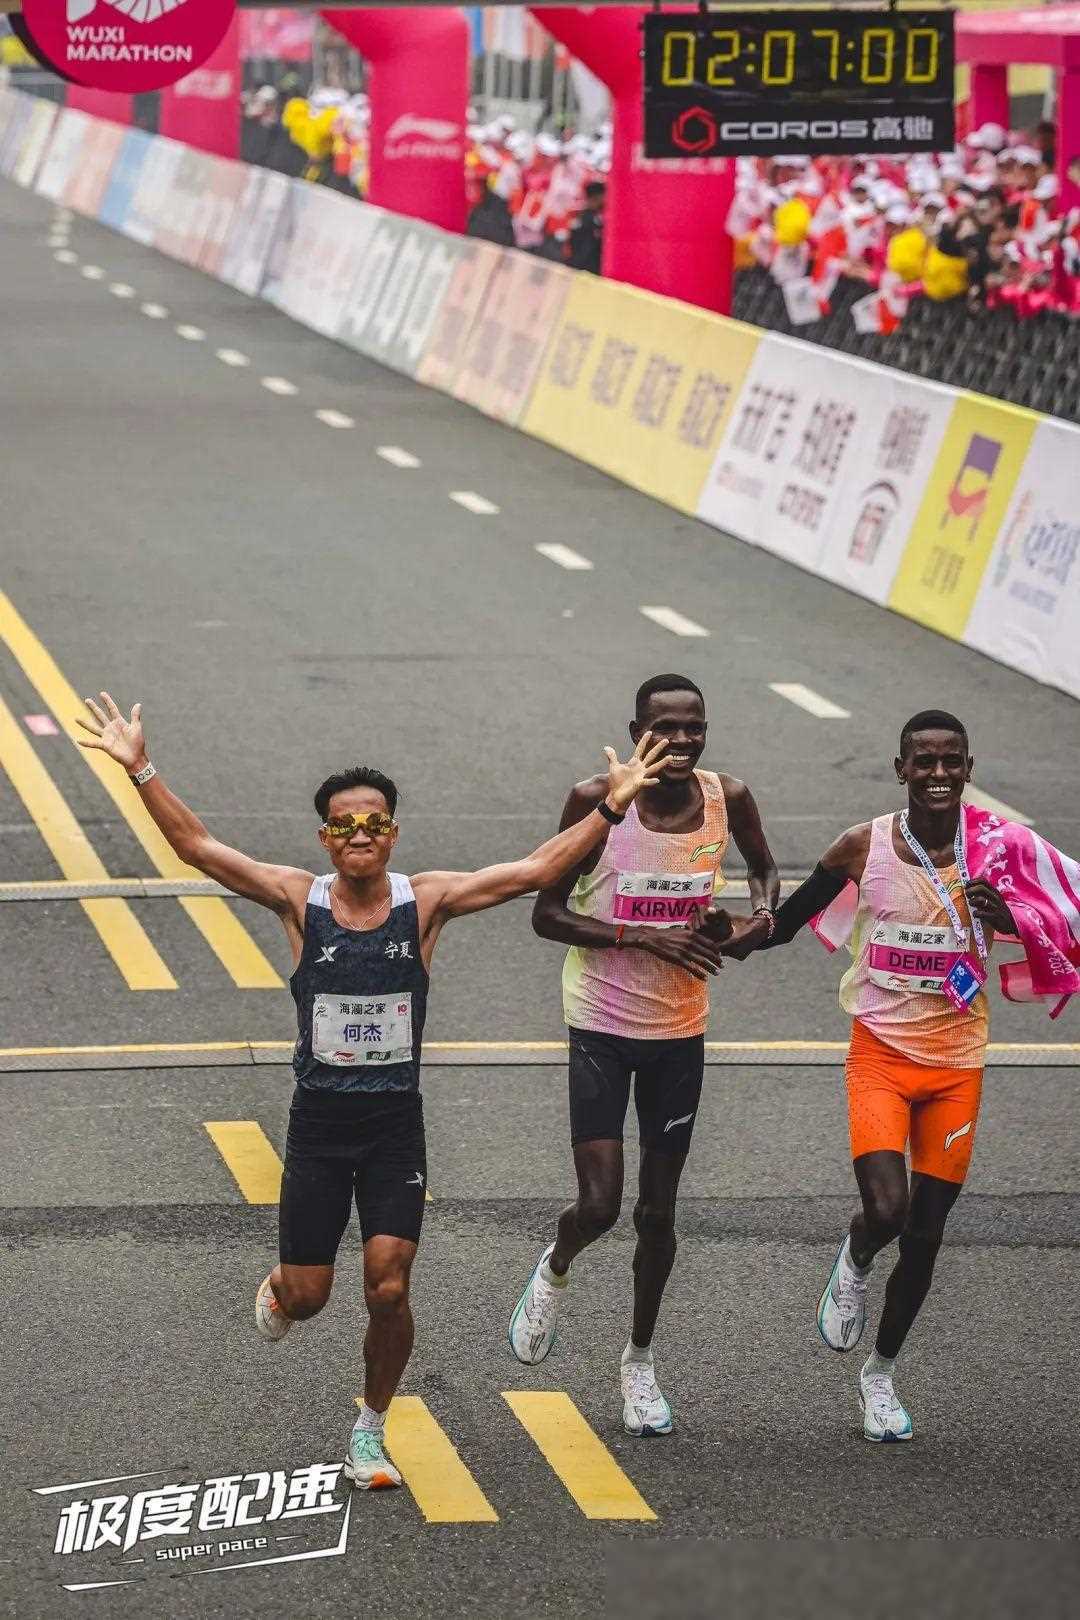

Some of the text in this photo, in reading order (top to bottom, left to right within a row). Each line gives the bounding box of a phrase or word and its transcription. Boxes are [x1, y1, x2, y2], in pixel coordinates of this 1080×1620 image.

[66, 26, 125, 43] WUXI
[66, 44, 193, 62] MARATHON
[662, 28, 939, 86] 02:07:00
[720, 116, 933, 141] COROS 高驰
[647, 880, 693, 892] 海澜之家
[898, 930, 946, 945] 海澜之家
[385, 940, 413, 959] 宁夏
[889, 952, 946, 972] DEME
[339, 1003, 387, 1015] 海澜之家
[343, 1023, 382, 1042] 何杰
